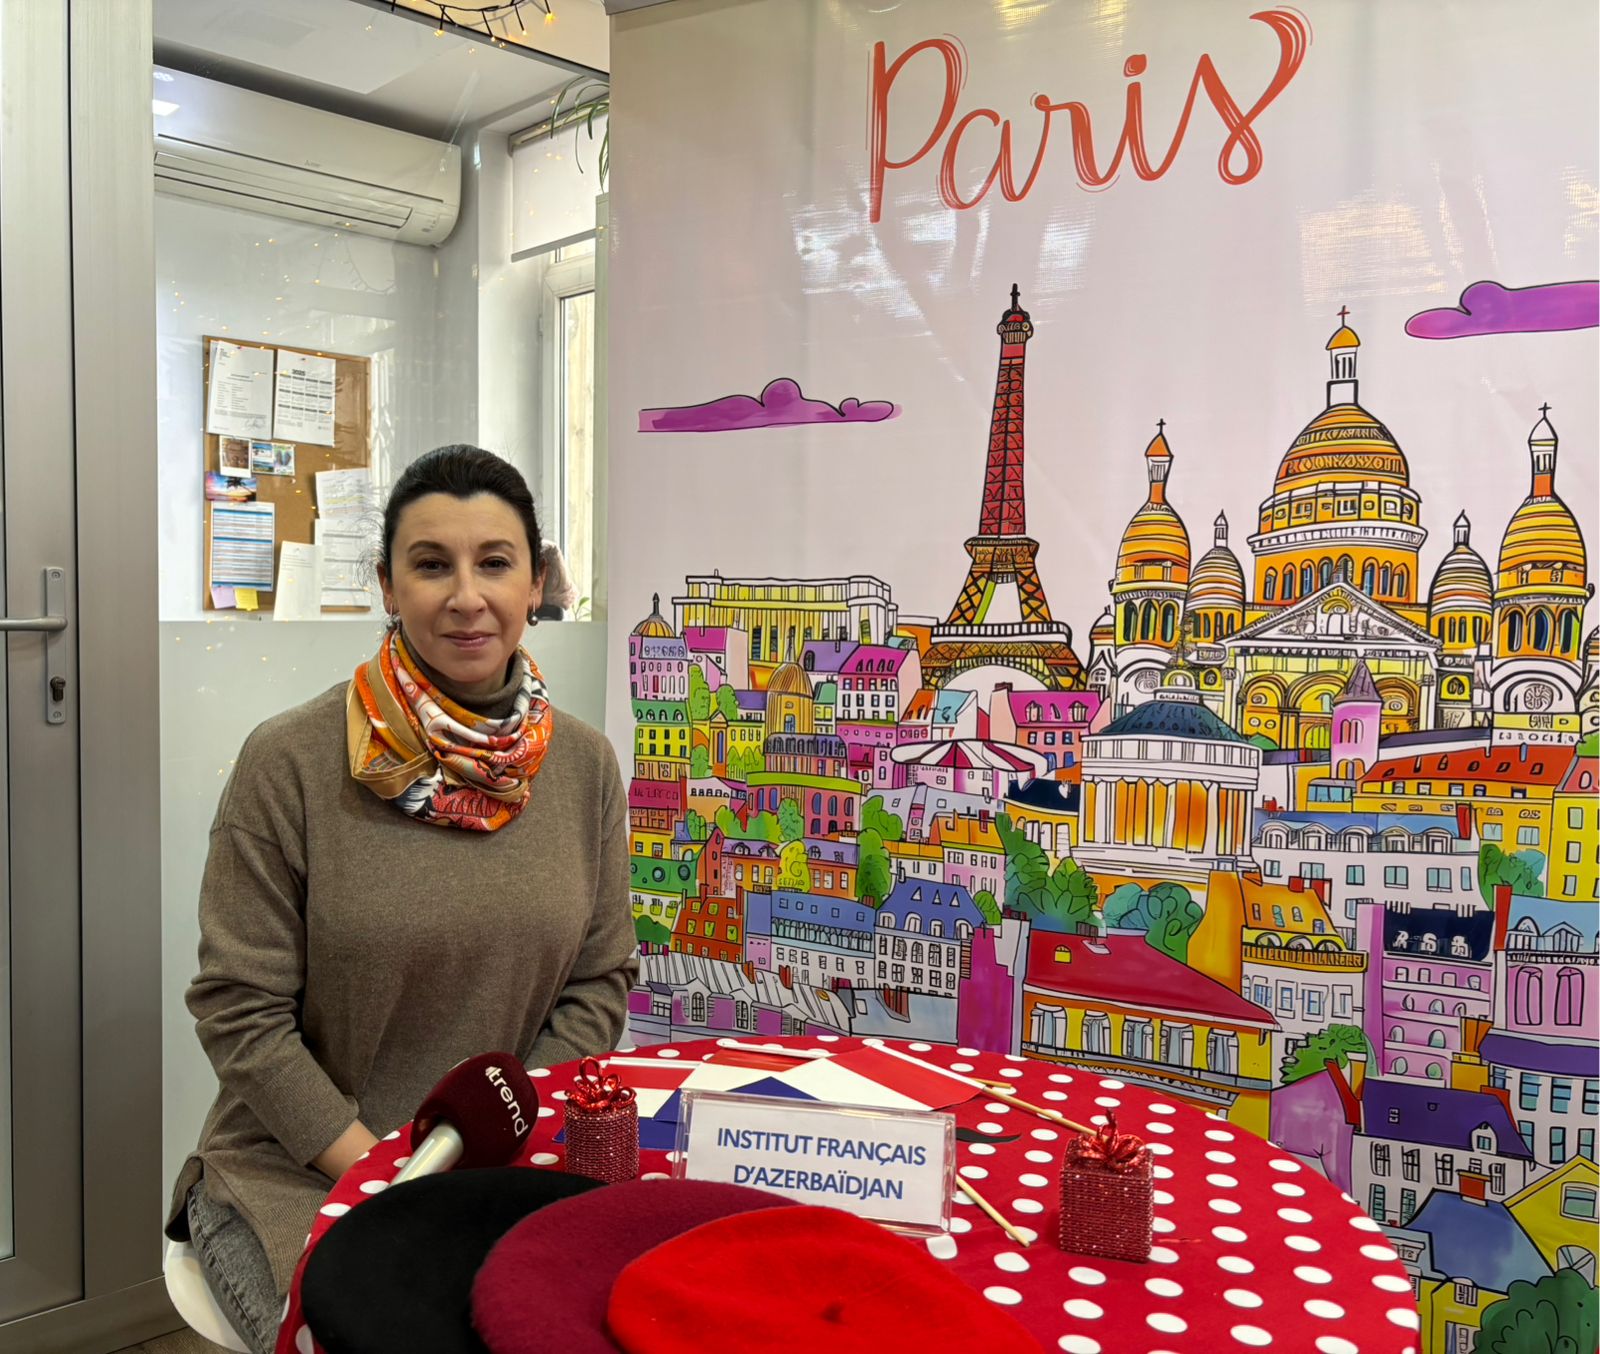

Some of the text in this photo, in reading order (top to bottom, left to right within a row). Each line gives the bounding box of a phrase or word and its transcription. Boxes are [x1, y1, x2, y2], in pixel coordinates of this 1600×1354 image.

[868, 8, 1309, 223] Paris
[487, 1066, 529, 1137] trend
[717, 1128, 927, 1167] INSTITUT FRANÇAIS
